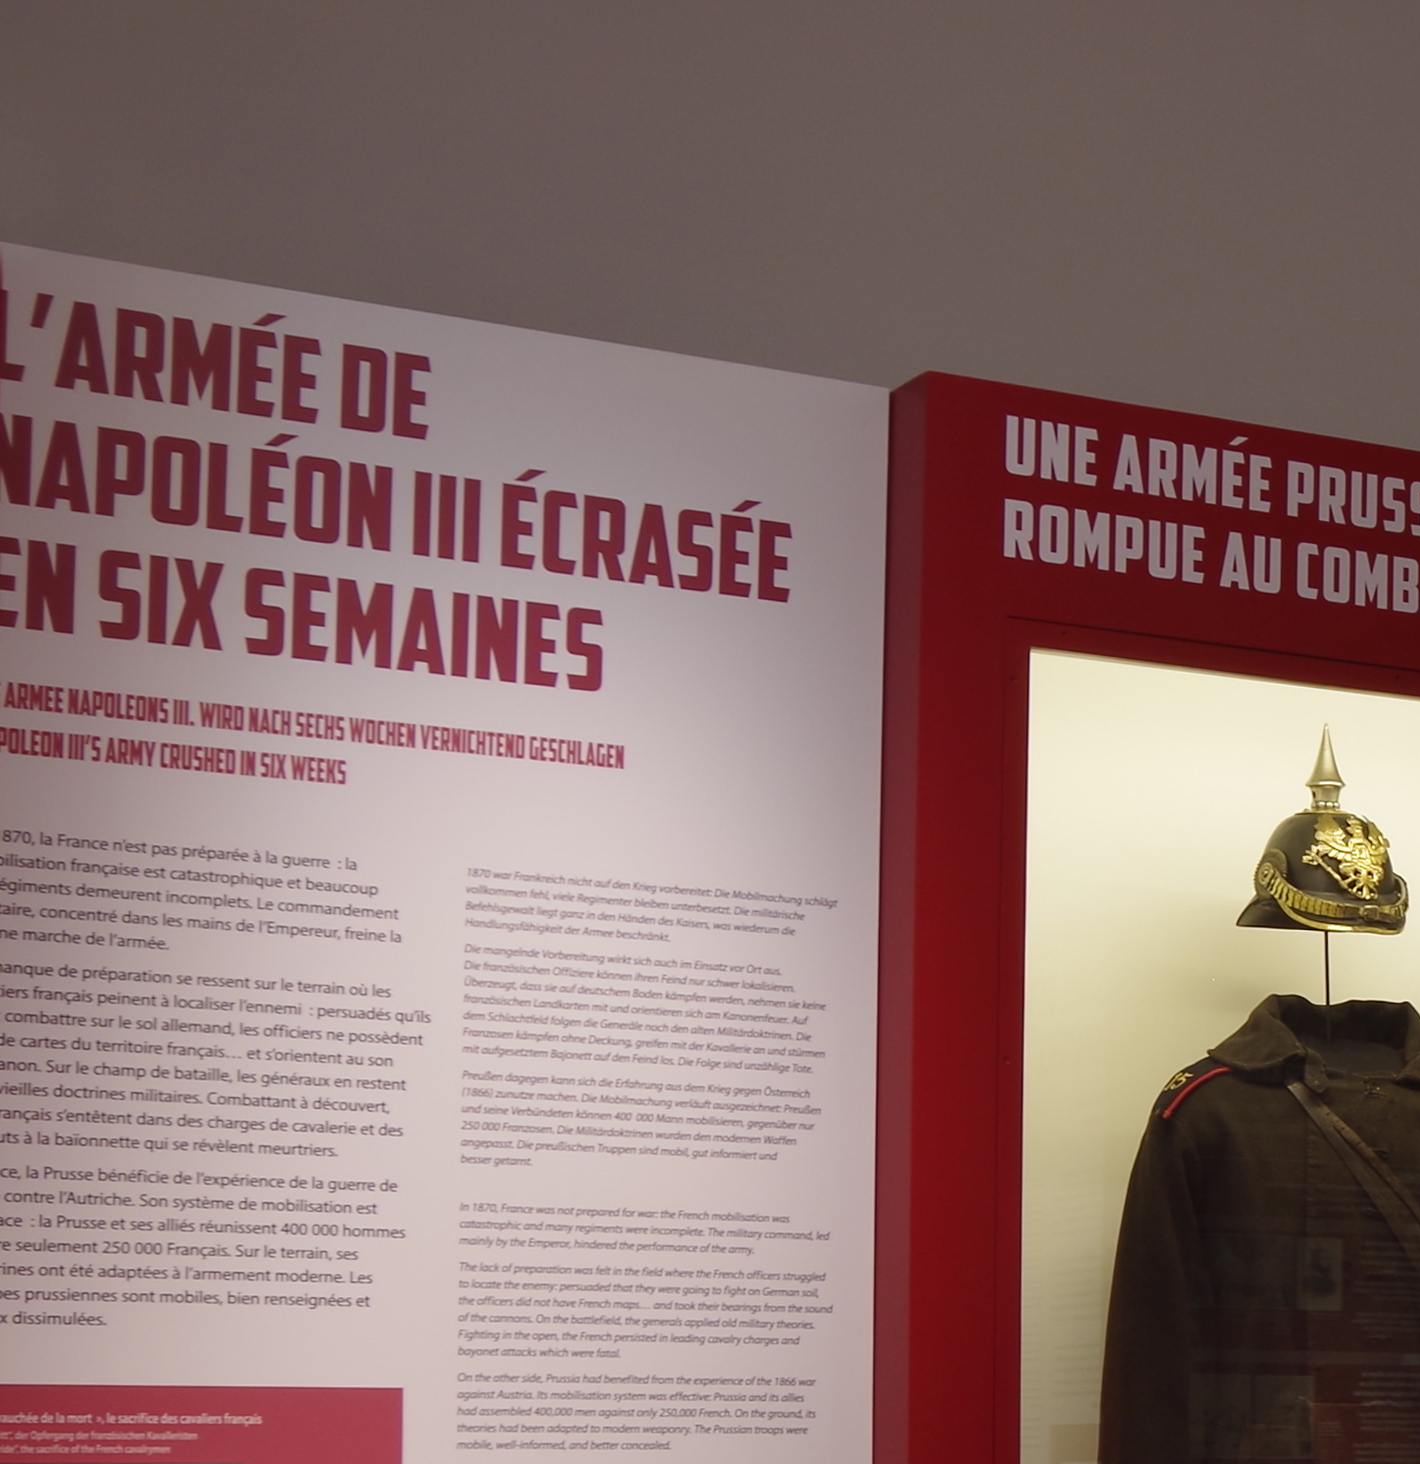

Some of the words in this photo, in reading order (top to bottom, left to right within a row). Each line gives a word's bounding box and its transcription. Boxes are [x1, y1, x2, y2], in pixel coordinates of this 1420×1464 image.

[0, 290, 320, 424] L'ARMÉE
[339, 343, 430, 440] DE
[0, 412, 393, 552] NAPOLÉON
[412, 470, 481, 563] III
[500, 468, 792, 602] ÉCRASÉE
[1004, 414, 1098, 486] UNE
[1113, 433, 1271, 513] ARMÉE
[1002, 497, 1205, 584] ROMPUE
[1219, 531, 1282, 594] AU
[98, 549, 222, 651] SIX
[244, 567, 603, 692] SEMAINES
[3, 681, 64, 713] ARMEE
[67, 688, 169, 723] NAPOLEONS
[172, 698, 194, 726] III.
[199, 701, 244, 731] WIRD
[248, 706, 291, 736] NACH
[294, 711, 345, 741] SECHS
[348, 716, 416, 748] WOCHEN
[419, 724, 525, 759] VERNICHTEND
[528, 735, 625, 769] GESCHLAGEN
[104, 737, 156, 767] ARMY
[159, 742, 236, 774] CRUSHED
[239, 750, 256, 776] IN
[259, 751, 286, 779] SIX
[290, 754, 346, 785] WEEKS
[2, 829, 36, 847] 870,
[39, 831, 53, 846] la
[56, 833, 109, 851] France
[112, 839, 147, 854] n'est
[150, 844, 178, 857] pas
[180, 845, 249, 862] préparée
[252, 849, 261, 863] à
[264, 850, 278, 864] la
[280, 855, 330, 869] guerre
[344, 857, 357, 871] la
[69, 857, 140, 878] française
[142, 867, 166, 879] est
[168, 869, 283, 889] catastrophique
[286, 878, 301, 889] et
[304, 877, 379, 898] beaucoup
[38, 907, 118, 923] concentré
[120, 910, 158, 926] dans
[161, 912, 183, 927] les
[186, 917, 232, 931] mains
[234, 918, 255, 932] de
[258, 920, 342, 940] l'Empereur,
[344, 925, 386, 942] freine
[389, 929, 402, 943] la
[74, 883, 162, 902] demeurent
[165, 889, 252, 909] incomplets.
[256, 897, 274, 911] Le
[276, 901, 399, 920] commandement
